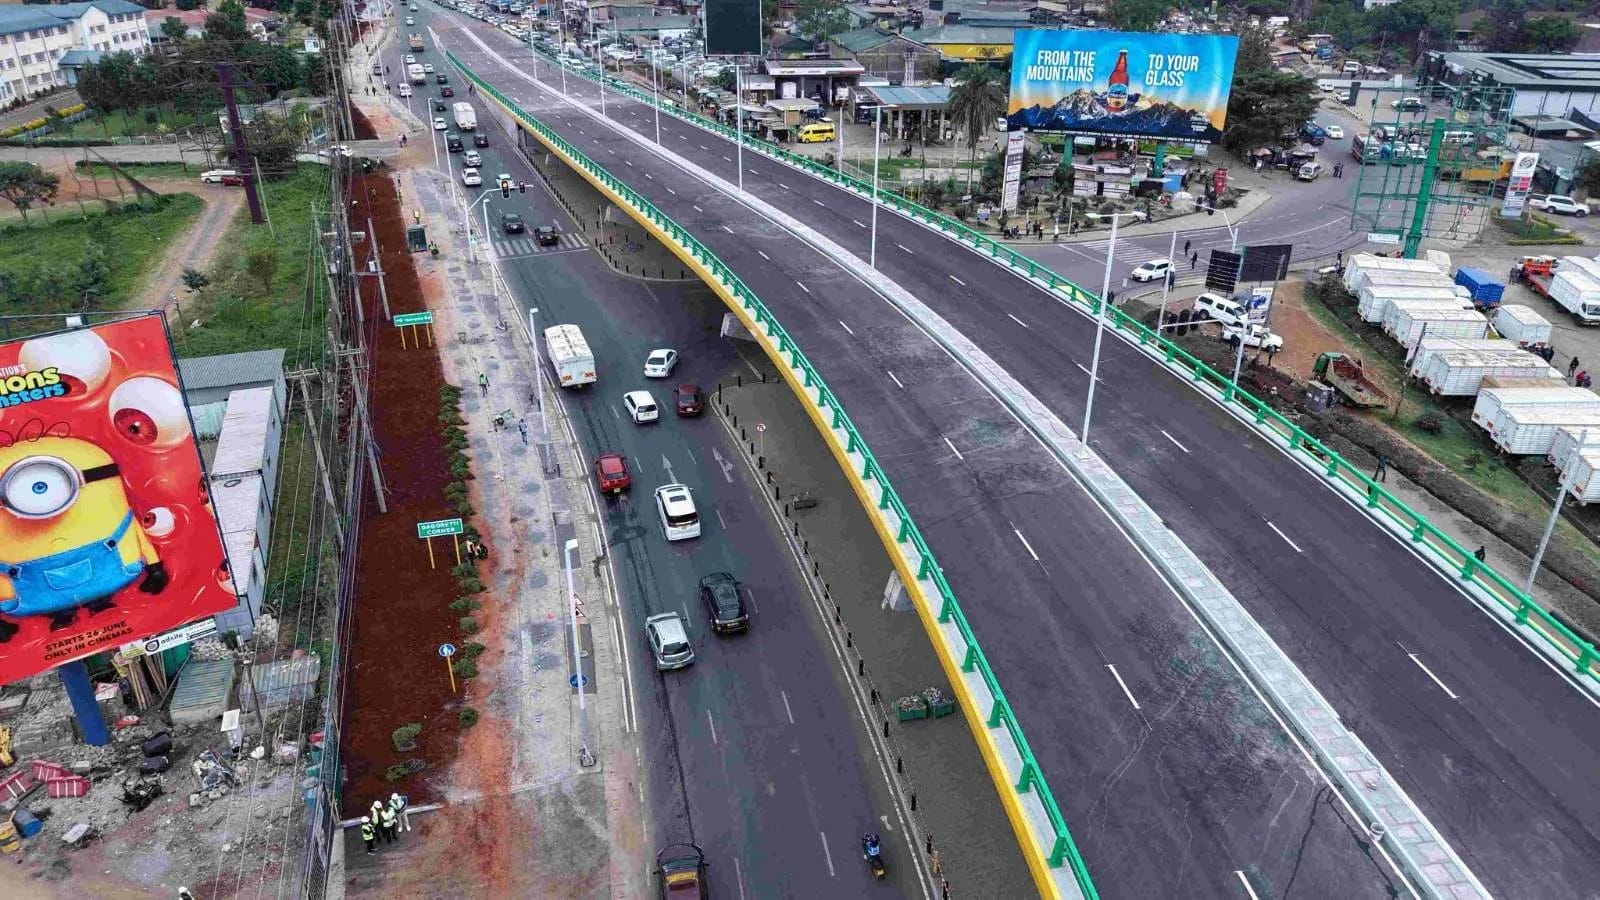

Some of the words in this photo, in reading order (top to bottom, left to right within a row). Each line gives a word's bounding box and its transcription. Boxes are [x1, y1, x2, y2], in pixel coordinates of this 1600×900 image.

[1037, 50, 1070, 66] FROM
[1073, 51, 1096, 67] THE
[1148, 54, 1163, 70] TO
[1167, 54, 1199, 71] YOUR
[1026, 65, 1094, 82] MOUNTAINS
[1145, 70, 1184, 87] GLASS
[421, 521, 459, 530] DAGORETTI
[426, 527, 455, 535] CORNER
[44, 647, 72, 661] ONLY
[75, 643, 85, 651] IN
[87, 627, 134, 647] CINEMAS
[46, 634, 84, 652] STARTS
[86, 630, 99, 639] 26
[102, 620, 127, 634] JUNE
